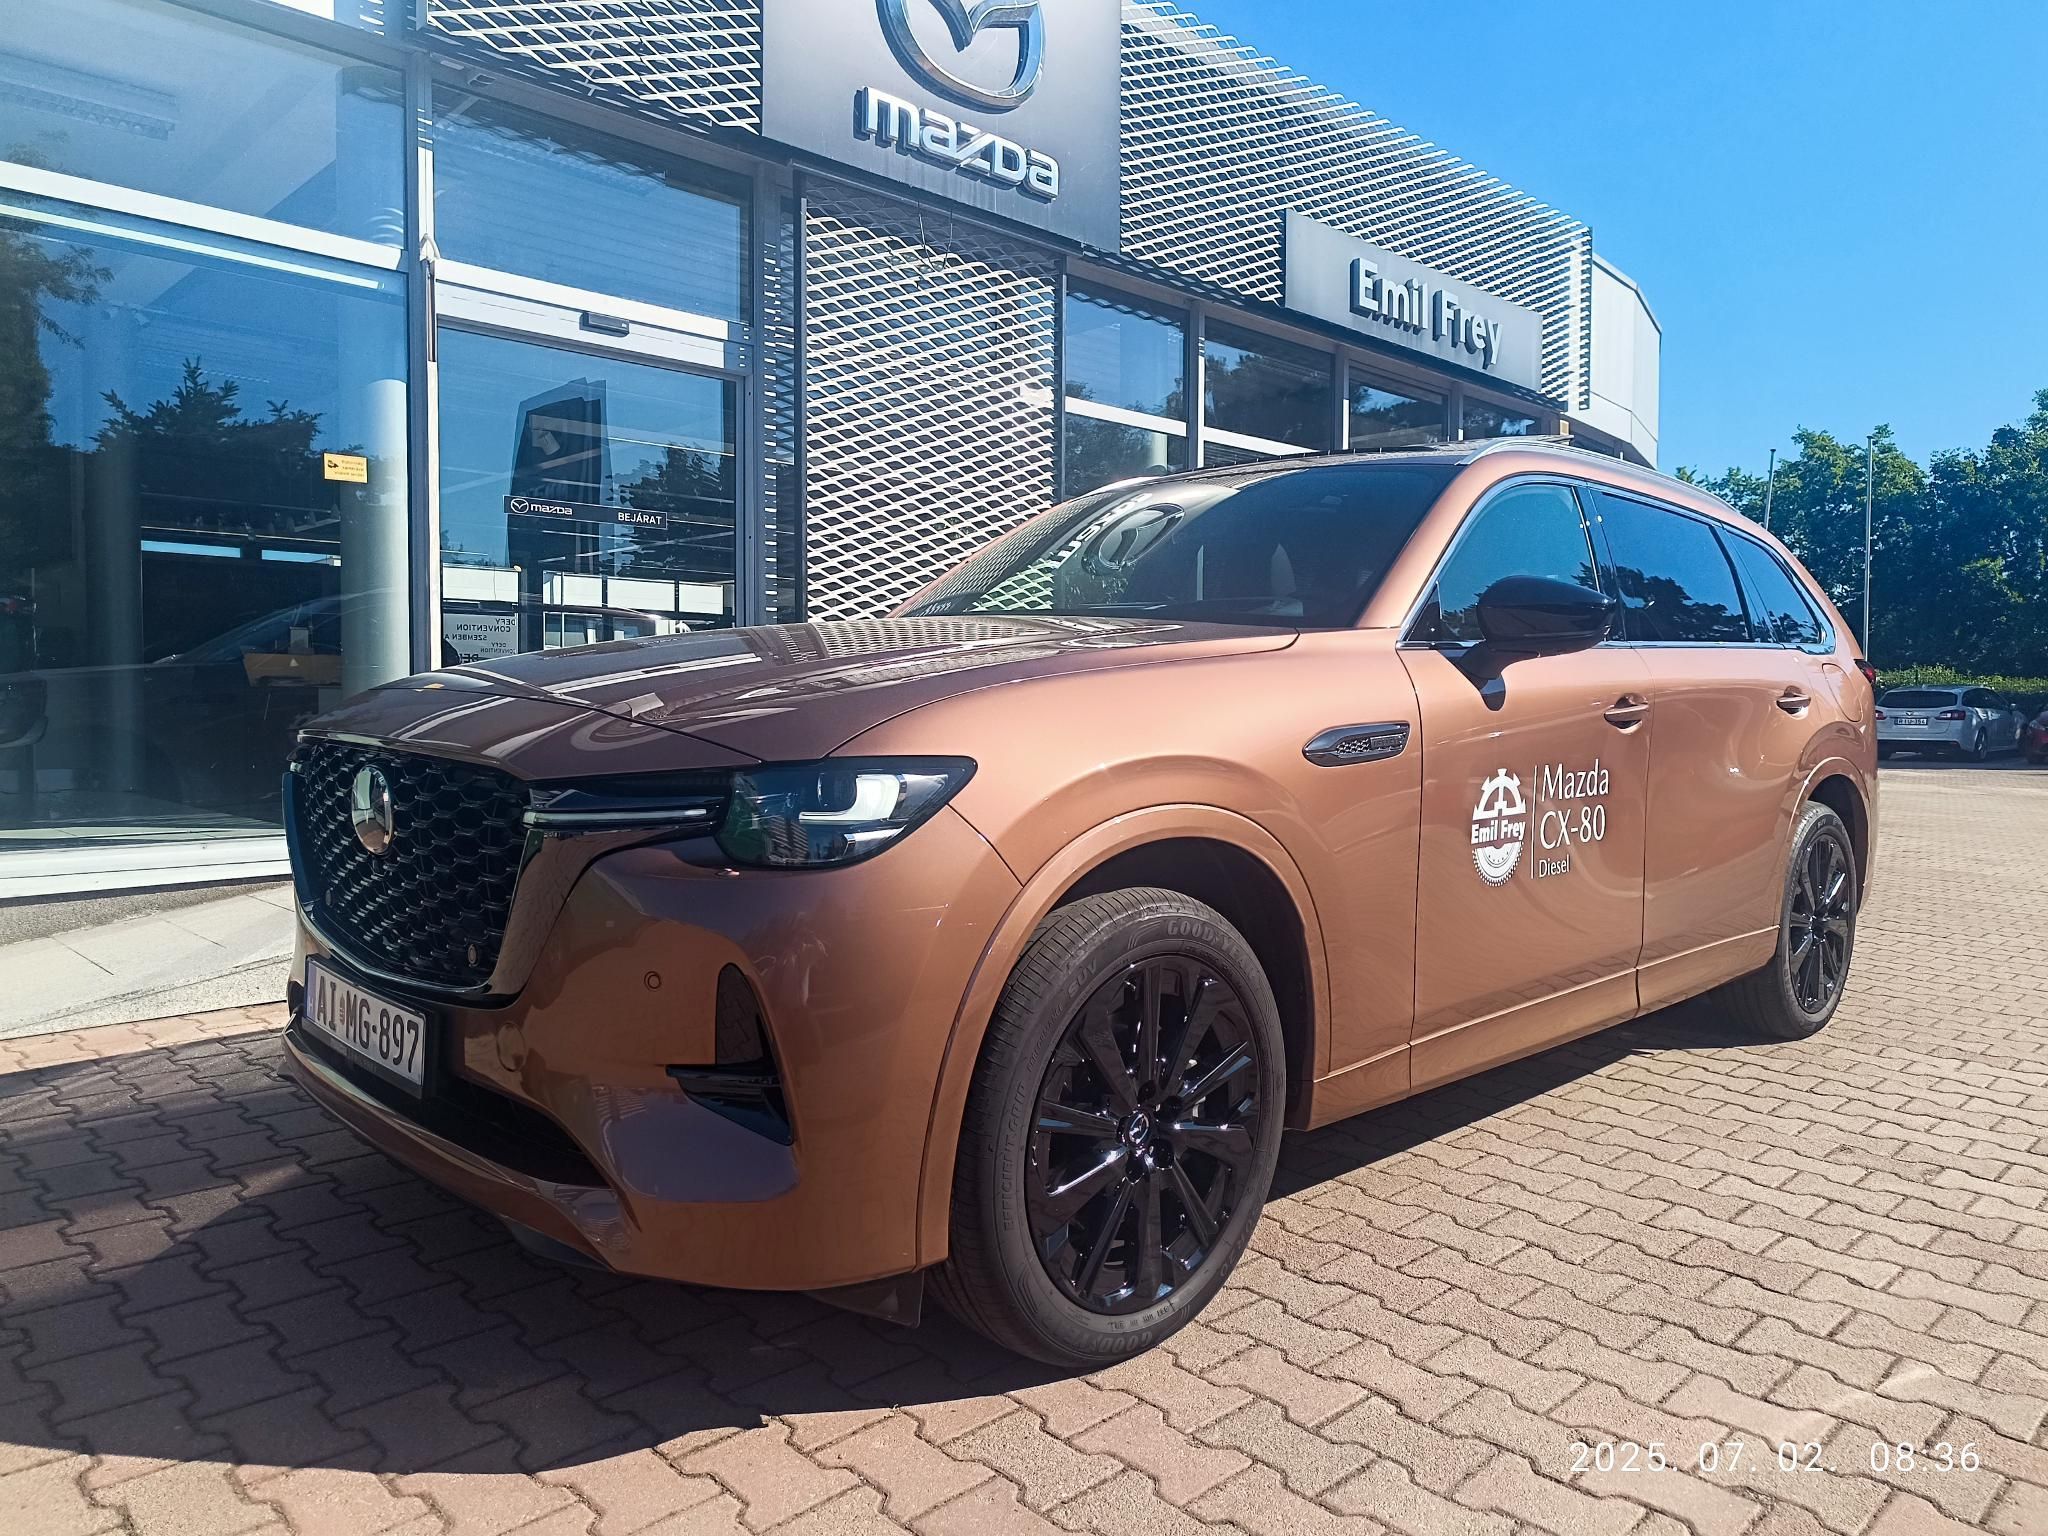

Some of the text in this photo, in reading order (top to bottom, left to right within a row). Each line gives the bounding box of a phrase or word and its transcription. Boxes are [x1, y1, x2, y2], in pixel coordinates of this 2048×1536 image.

[859, 86, 1060, 200] mazda
[1351, 257, 1503, 367] Emil Frey
[530, 503, 573, 516] mazda
[617, 511, 663, 525] BEJÁRAT
[1541, 758, 1609, 802] Mazda
[1470, 819, 1526, 845] Emil Frey
[1539, 804, 1606, 850] CX-80
[1539, 853, 1571, 878] Diesel
[345, 990, 420, 1074] MG-897
